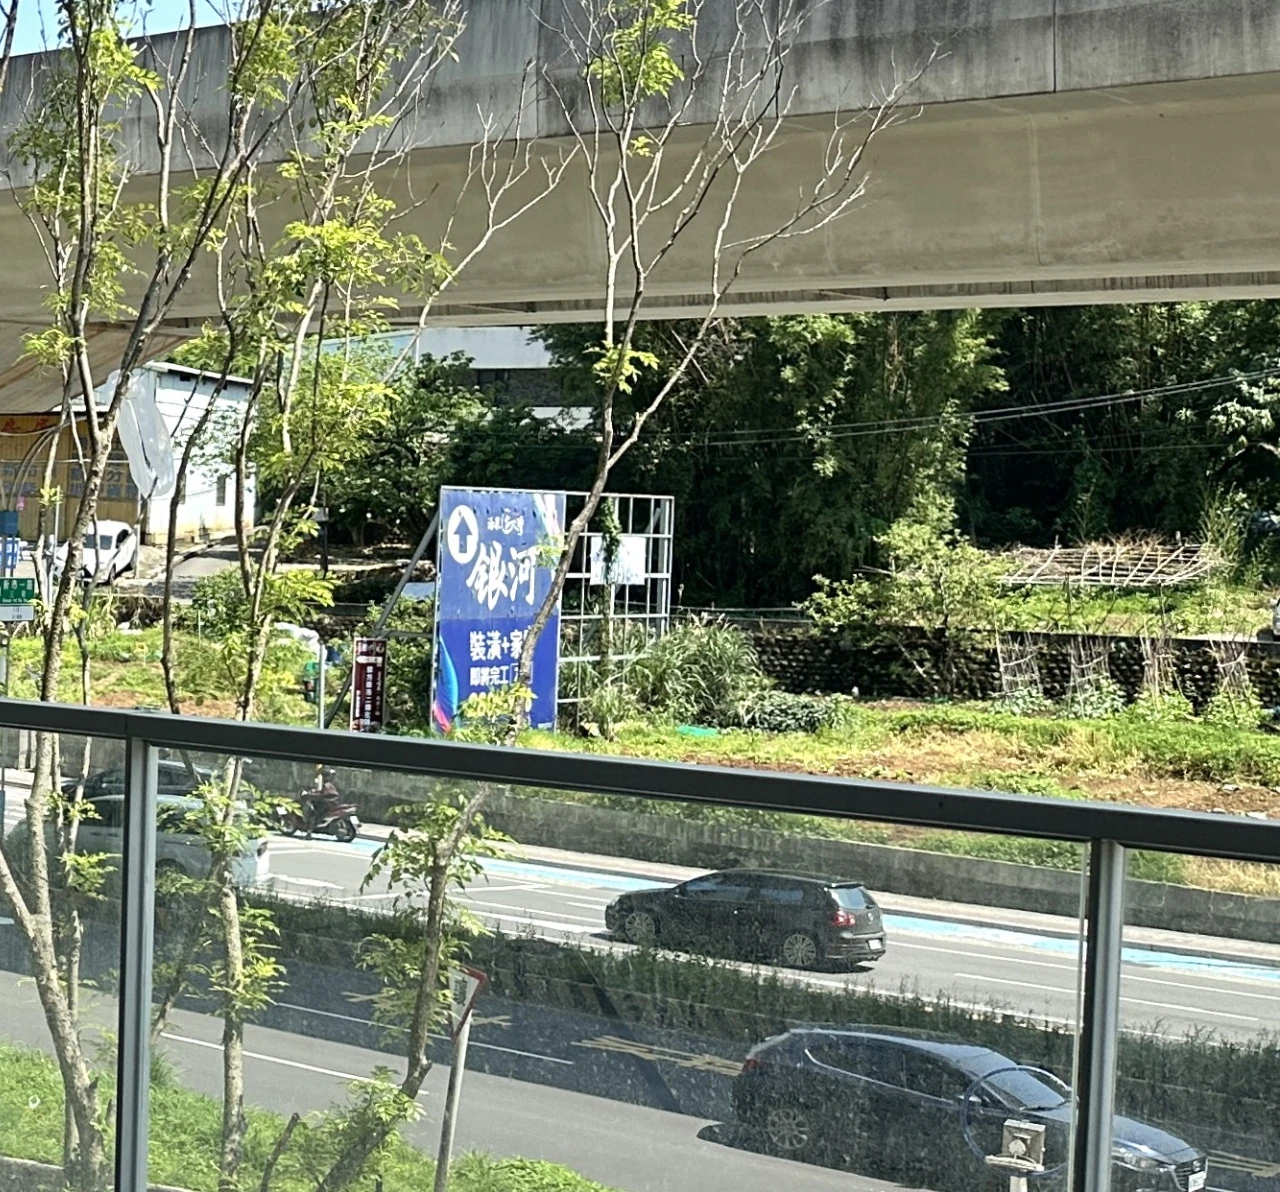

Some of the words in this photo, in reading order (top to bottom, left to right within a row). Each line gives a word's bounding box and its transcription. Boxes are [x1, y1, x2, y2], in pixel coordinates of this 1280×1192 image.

[466, 541, 538, 611] 銀河
[469, 628, 533, 662] 裝潢+家
[469, 665, 509, 687] 即將完工
